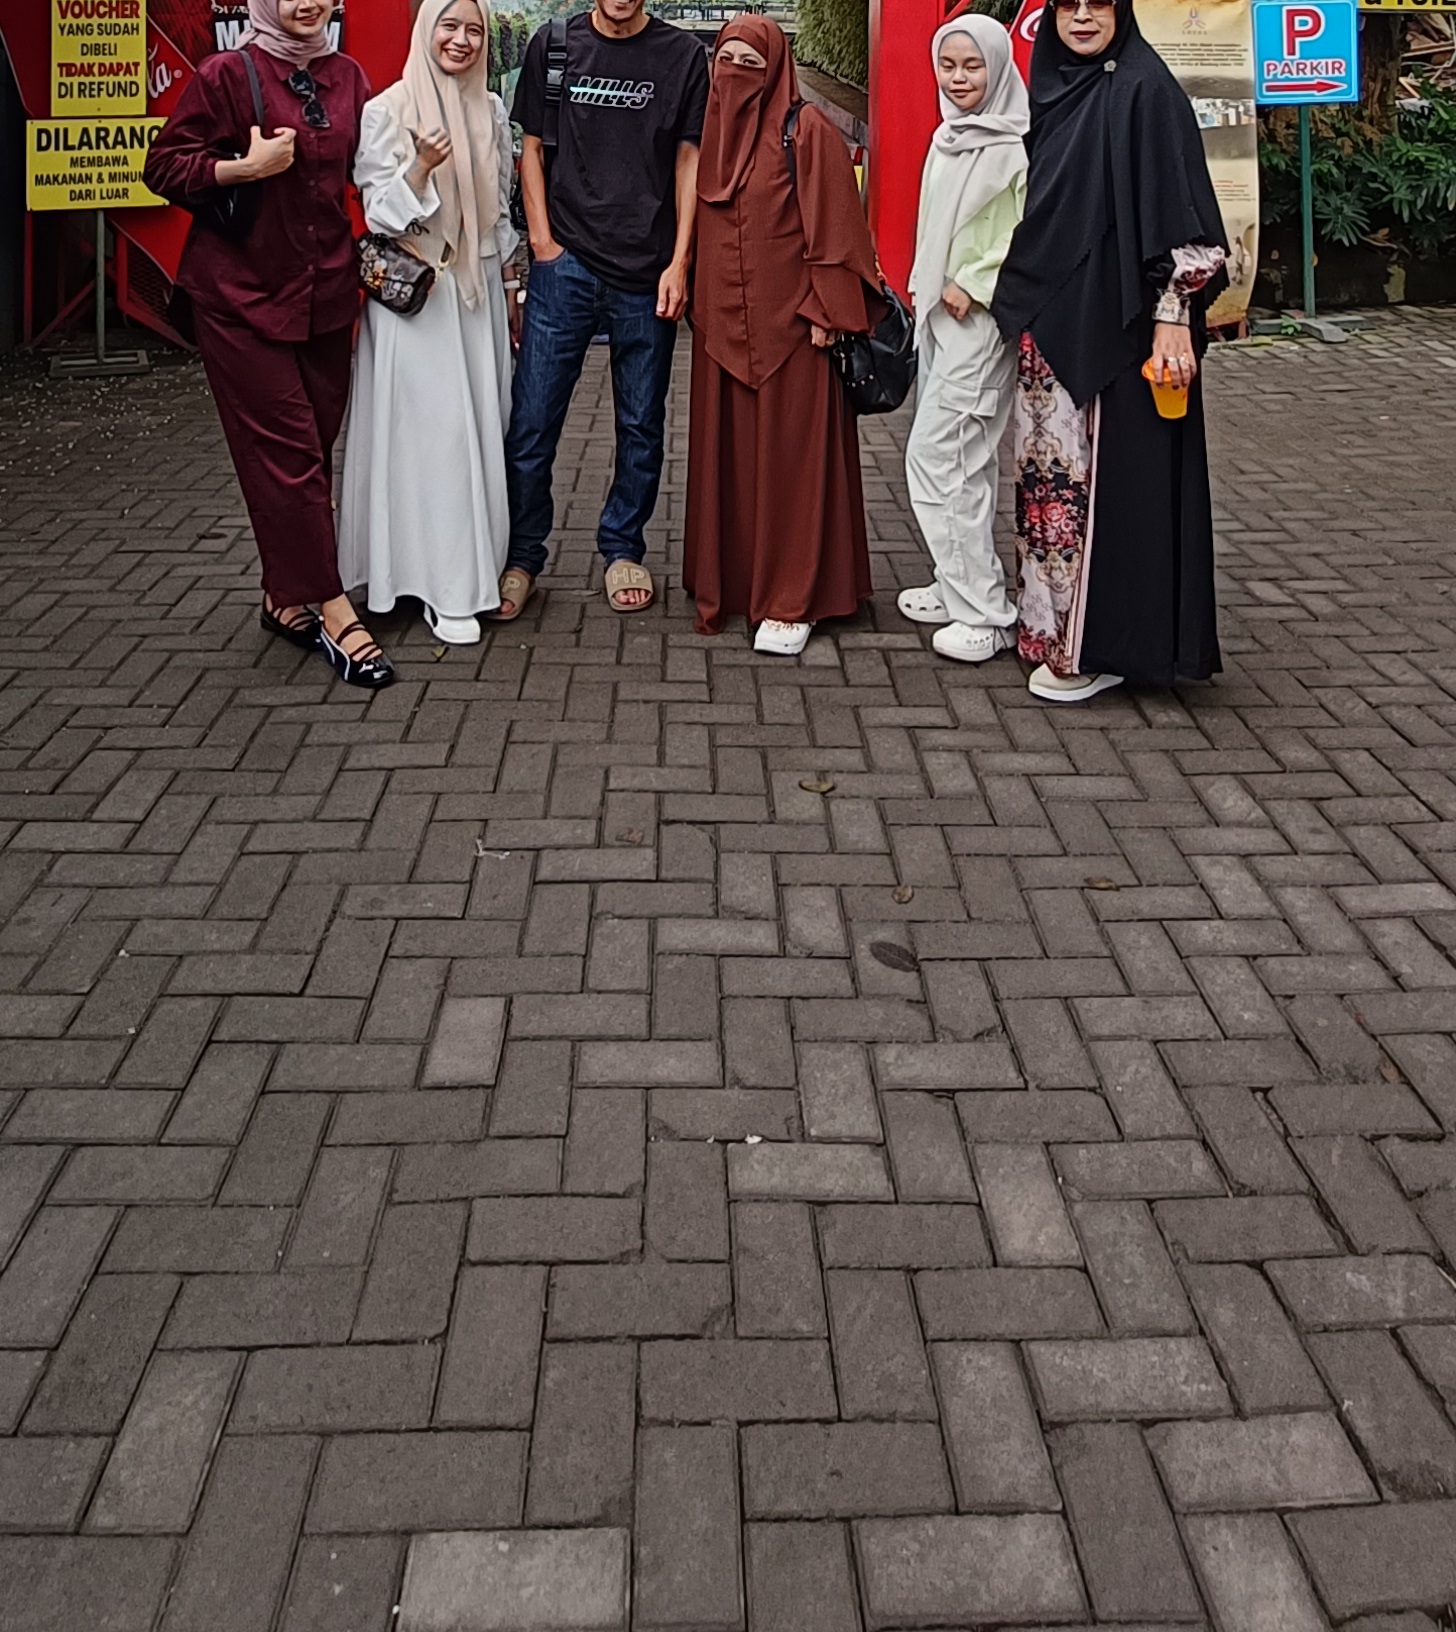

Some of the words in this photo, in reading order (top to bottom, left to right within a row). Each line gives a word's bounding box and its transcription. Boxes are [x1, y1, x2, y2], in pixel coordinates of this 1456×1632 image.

[57, 0, 140, 19] VOUCHER
[58, 23, 94, 36] YANG
[97, 23, 139, 36] SUDAH
[1283, 6, 1325, 58] P
[80, 43, 117, 56] DIBELI
[57, 62, 96, 77] TIDAK
[97, 62, 140, 77] DAPAT
[1264, 59, 1345, 78] PARKIR
[57, 81, 74, 98] DI
[77, 81, 139, 98] REFUND
[570, 76, 654, 109] MILLS
[70, 155, 129, 168] MEMBAWA
[35, 172, 92, 186] MAKANAN
[96, 172, 105, 184] &
[69, 189, 96, 201] DARI
[100, 188, 129, 200] LUAR
[612, 568, 645, 585] HP
[501, 577, 521, 593] P
